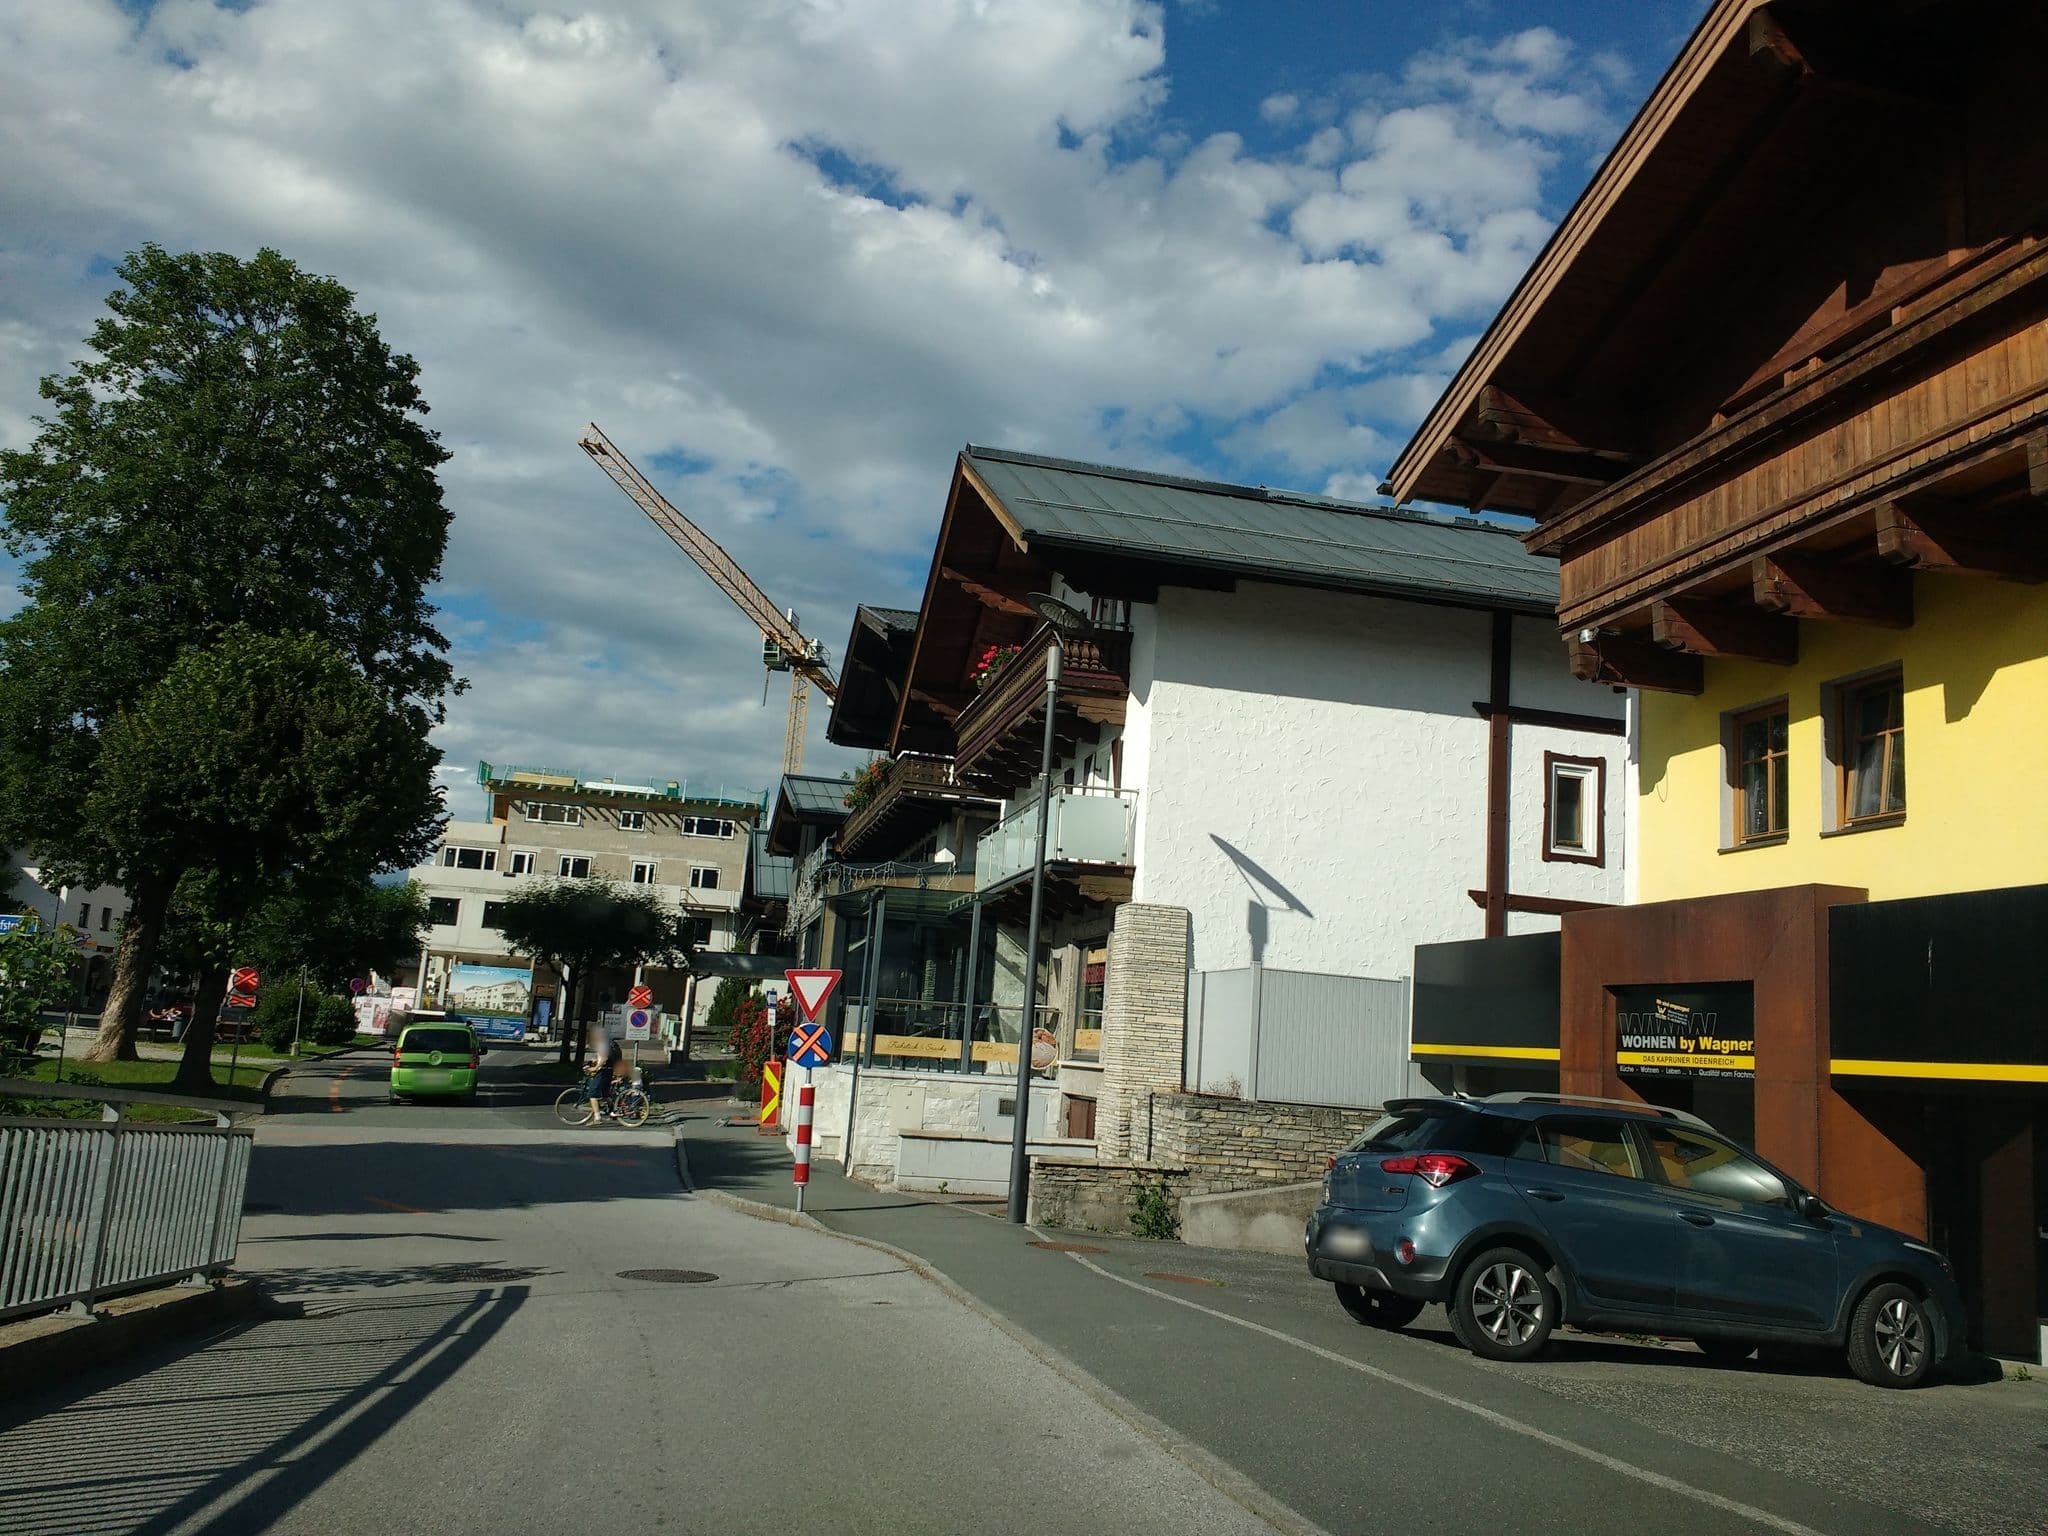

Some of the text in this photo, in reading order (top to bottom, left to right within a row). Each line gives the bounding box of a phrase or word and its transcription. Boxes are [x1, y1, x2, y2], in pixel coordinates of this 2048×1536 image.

[1621, 1035, 1754, 1054] WOHNEN by Wagner
[1656, 1056, 1691, 1064] KAPRUNER
[1692, 1057, 1735, 1066] IDEENREICH
